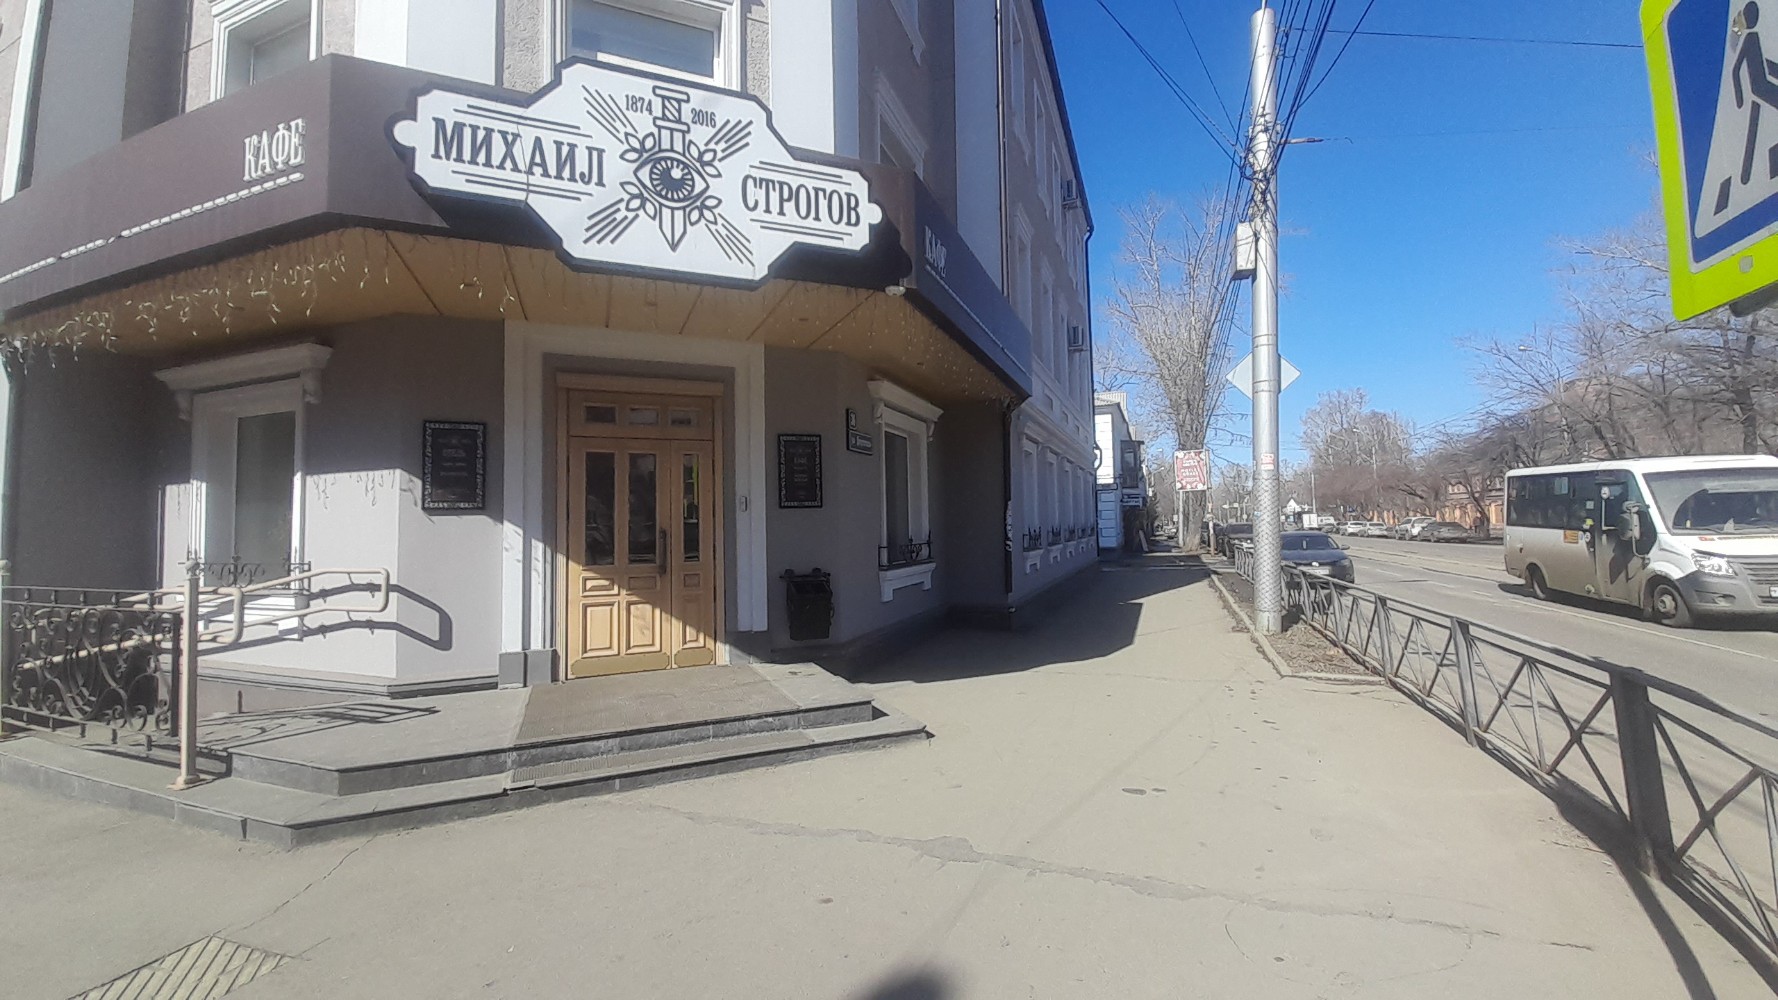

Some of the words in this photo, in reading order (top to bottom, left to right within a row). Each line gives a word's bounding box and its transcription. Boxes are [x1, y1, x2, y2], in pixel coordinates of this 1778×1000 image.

[625, 94, 653, 116] 1874
[690, 107, 717, 128] 2016
[243, 118, 306, 181] КАФЕ
[431, 116, 606, 188] МИХАИЛ
[741, 174, 861, 228] СТРОГОВ
